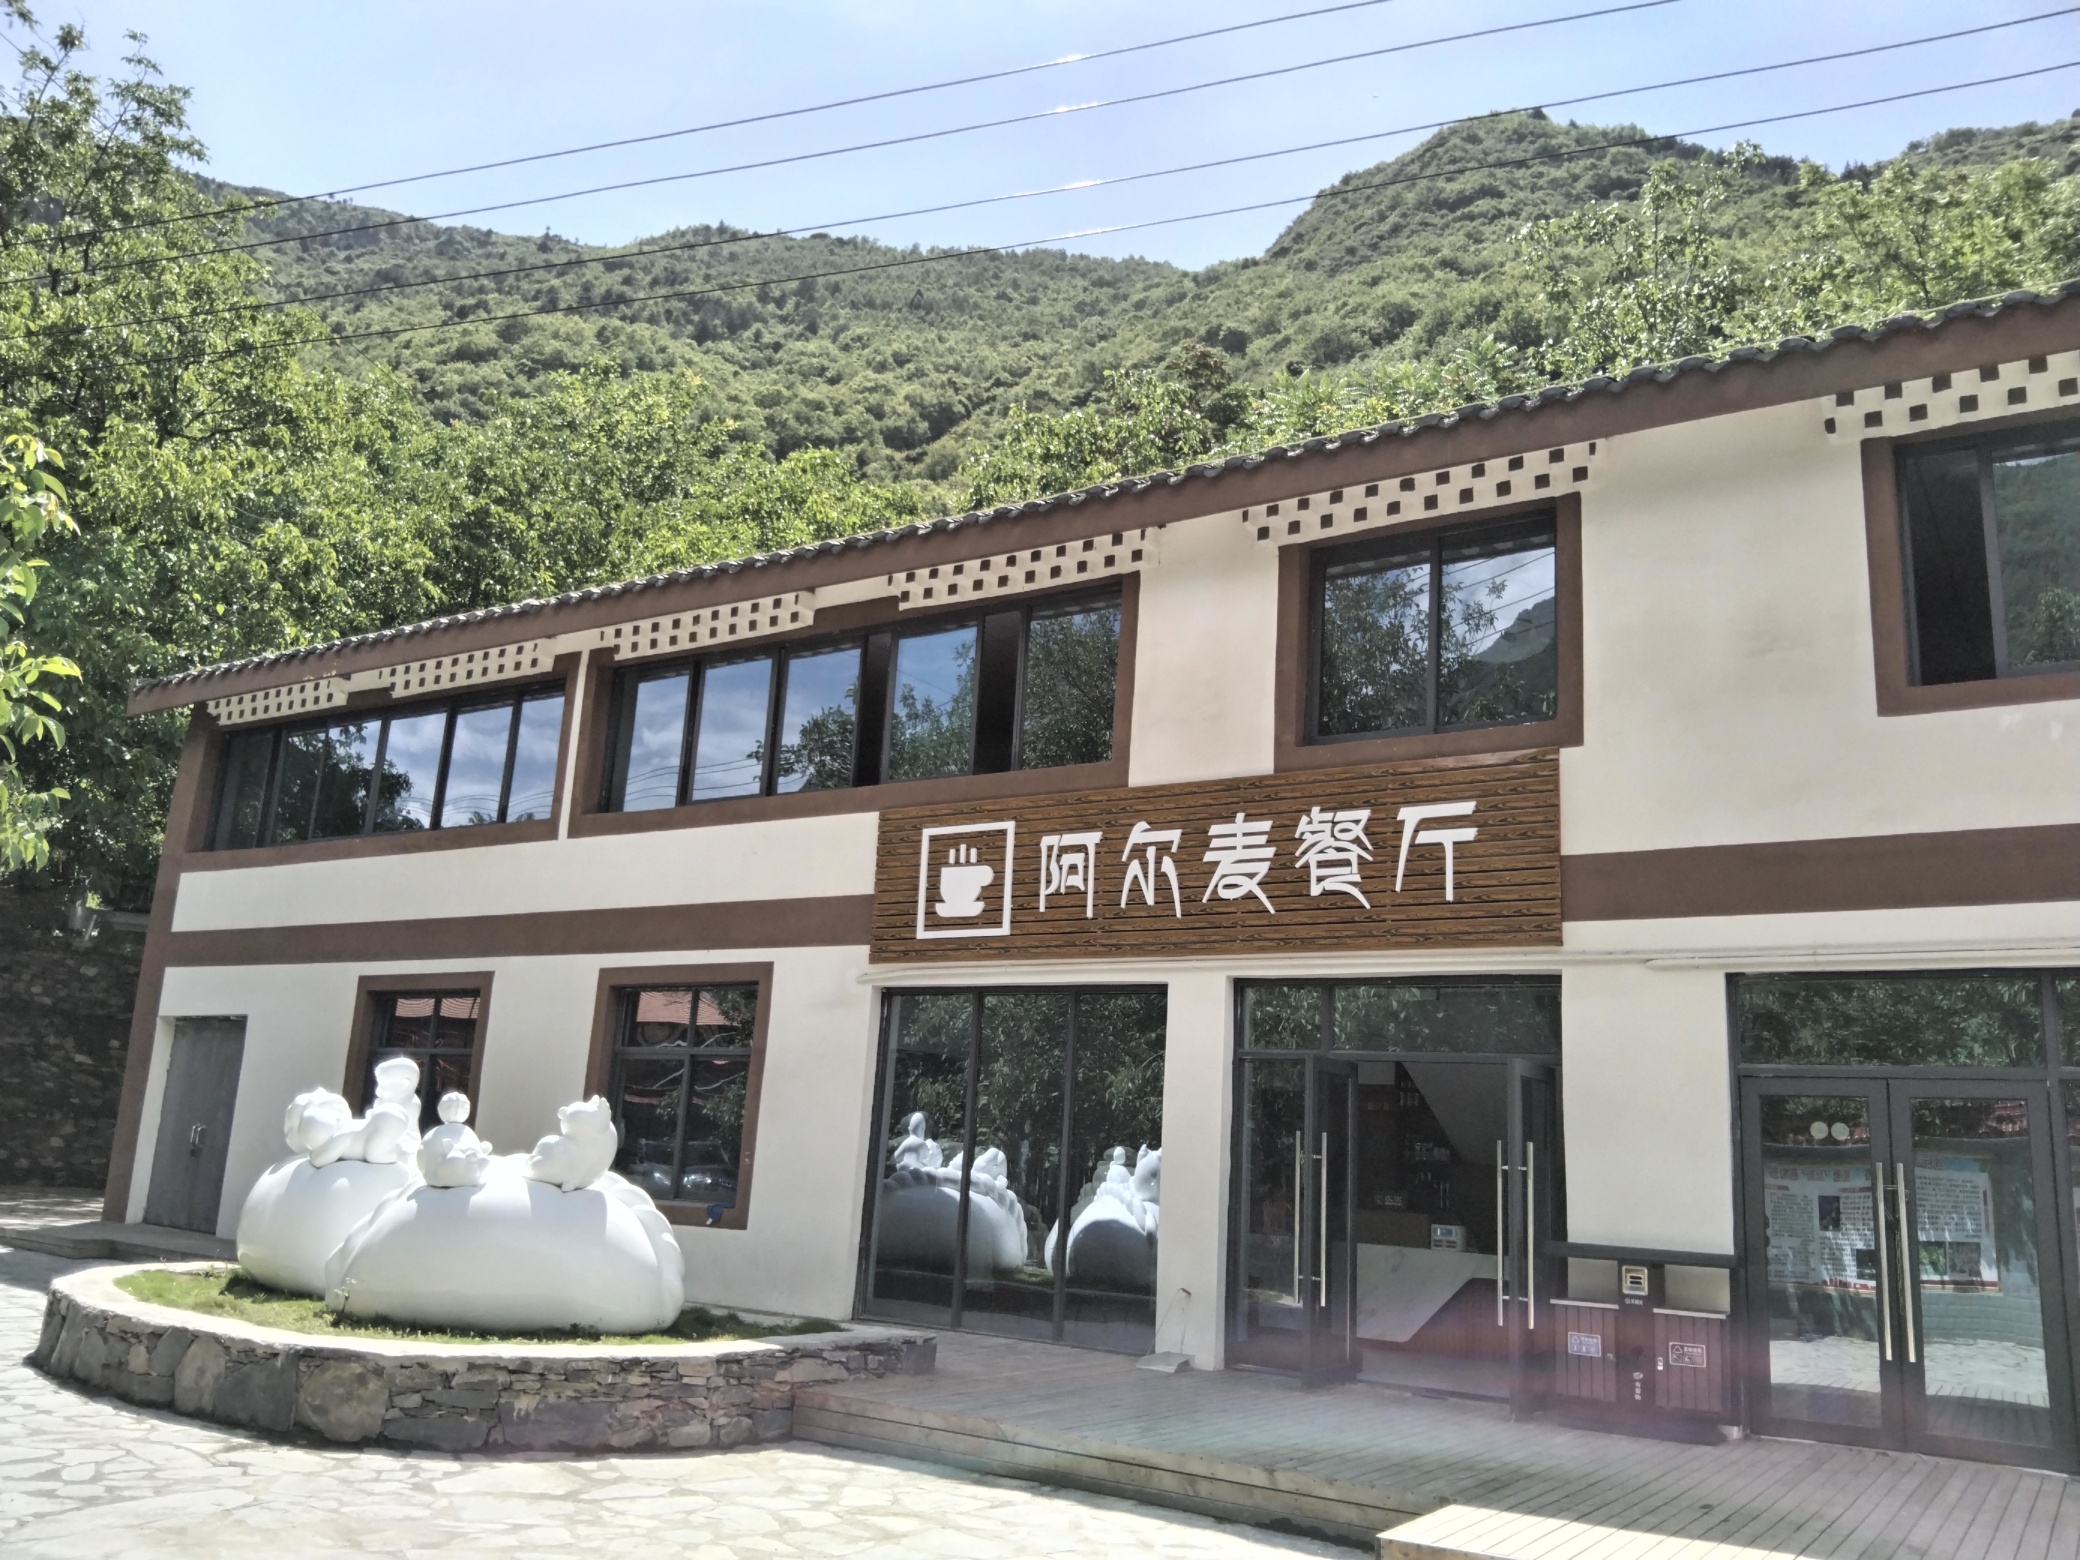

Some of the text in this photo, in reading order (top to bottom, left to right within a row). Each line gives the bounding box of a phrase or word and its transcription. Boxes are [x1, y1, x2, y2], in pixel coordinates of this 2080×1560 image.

[1039, 800, 1478, 918] 阿尔麦餐厅
